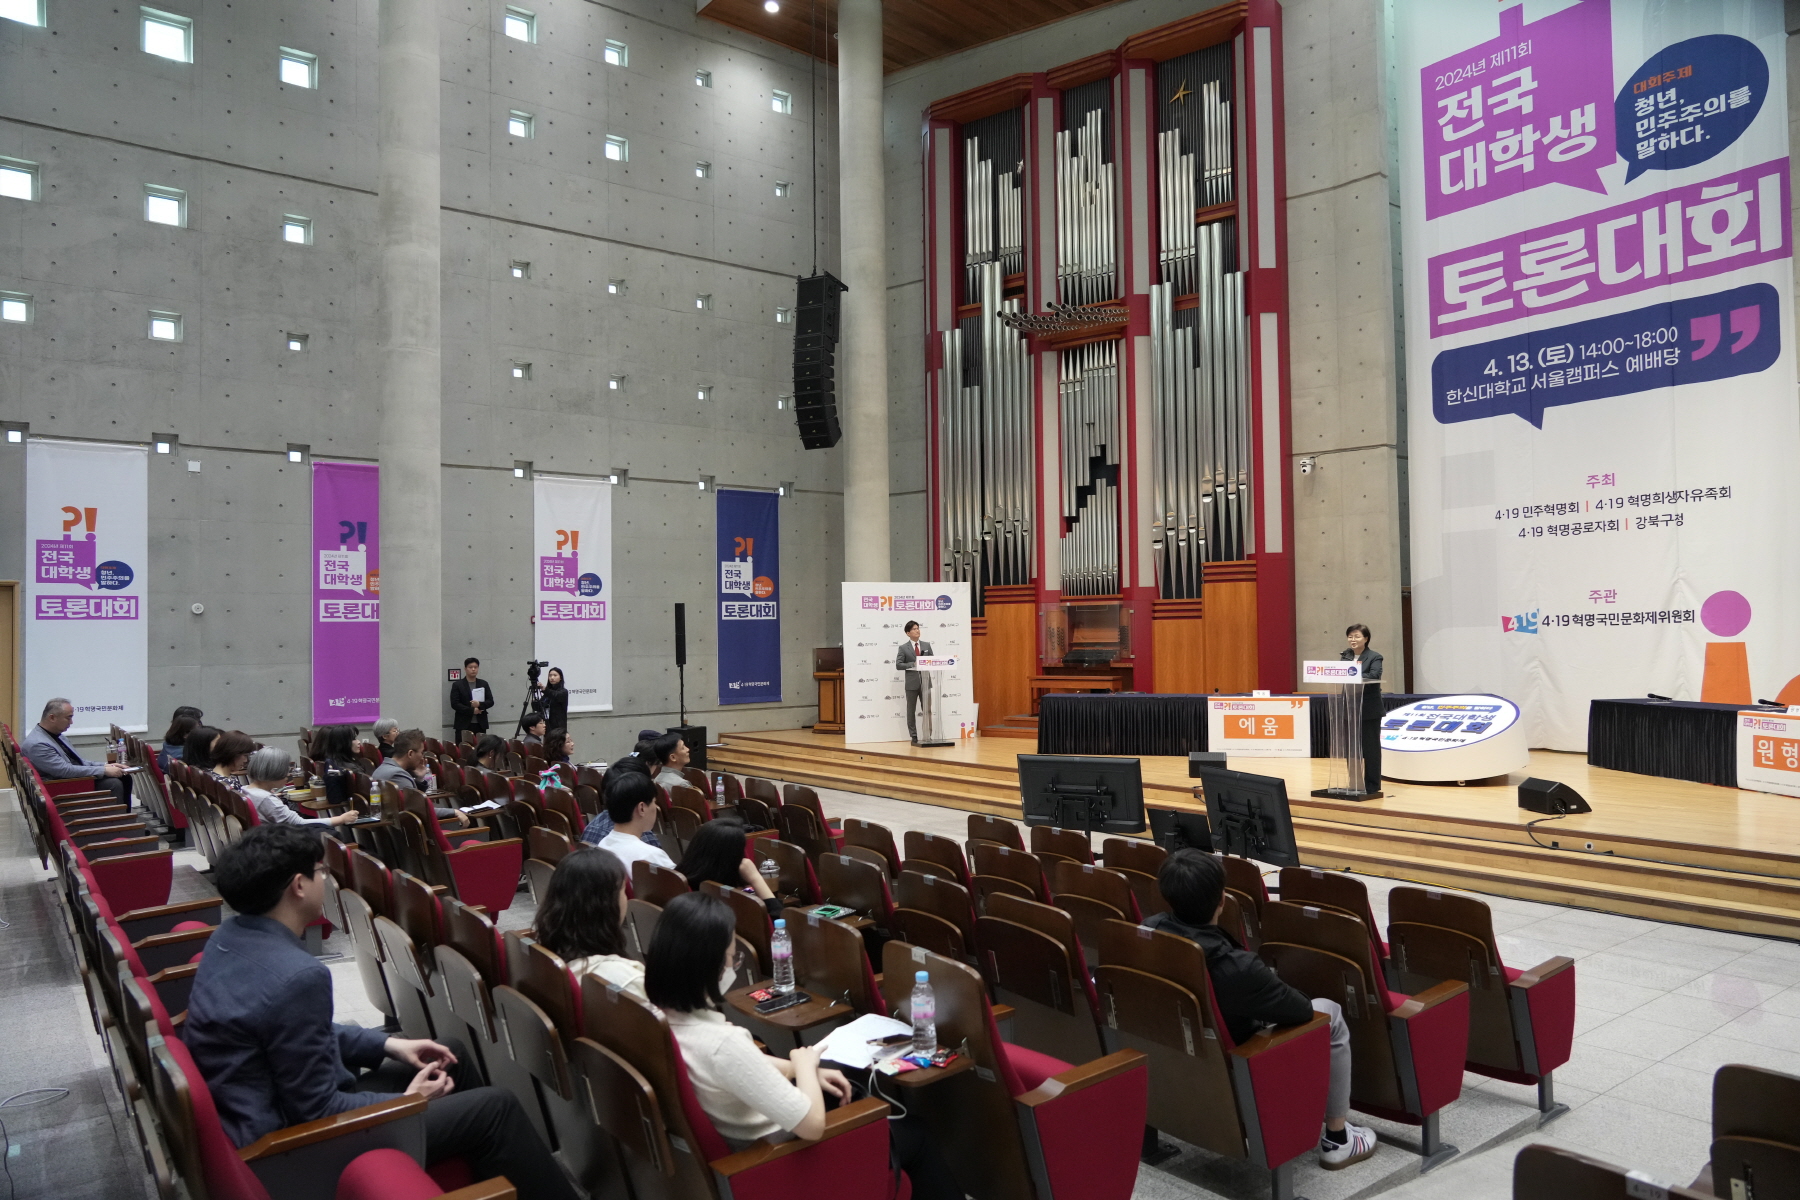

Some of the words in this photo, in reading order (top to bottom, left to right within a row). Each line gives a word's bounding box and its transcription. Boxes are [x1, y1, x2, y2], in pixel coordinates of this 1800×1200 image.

[1435, 58, 1486, 91] 2024년
[1489, 39, 1532, 69] 제11회
[1633, 65, 1693, 94] 대회주제
[1437, 66, 1538, 142] 전국
[1634, 87, 1685, 117] 청년,
[1635, 85, 1752, 138] 민주주의를
[1439, 102, 1598, 195] 대학생
[1636, 124, 1711, 160] 말하다.
[1437, 172, 1783, 325] 토론대회
[1579, 326, 1679, 360] 14:00~18:00
[1446, 377, 1527, 406] 한신대학교
[1531, 360, 1620, 390] 서울캠퍼스
[1625, 346, 1681, 373] 예배당
[1586, 472, 1616, 489] 주최
[1627, 485, 1732, 507] 혁명희생자유족회
[1522, 501, 1580, 519] 민주혁명회
[1547, 519, 1620, 537] 혁명공로자회
[1635, 513, 1684, 530] 강북구청
[41, 551, 75, 564] 전국
[324, 560, 349, 572] 전국
[41, 565, 91, 580] 대학생
[324, 573, 363, 586] 대학생
[543, 565, 565, 576] 전국
[724, 570, 742, 579] 전국
[543, 577, 576, 588] 대학생
[725, 580, 750, 590] 대학생
[895, 600, 935, 611] 토론대회
[1588, 589, 1618, 604] 주관
[39, 597, 136, 618] 토론대회
[542, 602, 604, 619] 토론대회
[723, 603, 775, 618] 토론대회
[1572, 609, 1695, 627] 혁명국민문화제위원회
